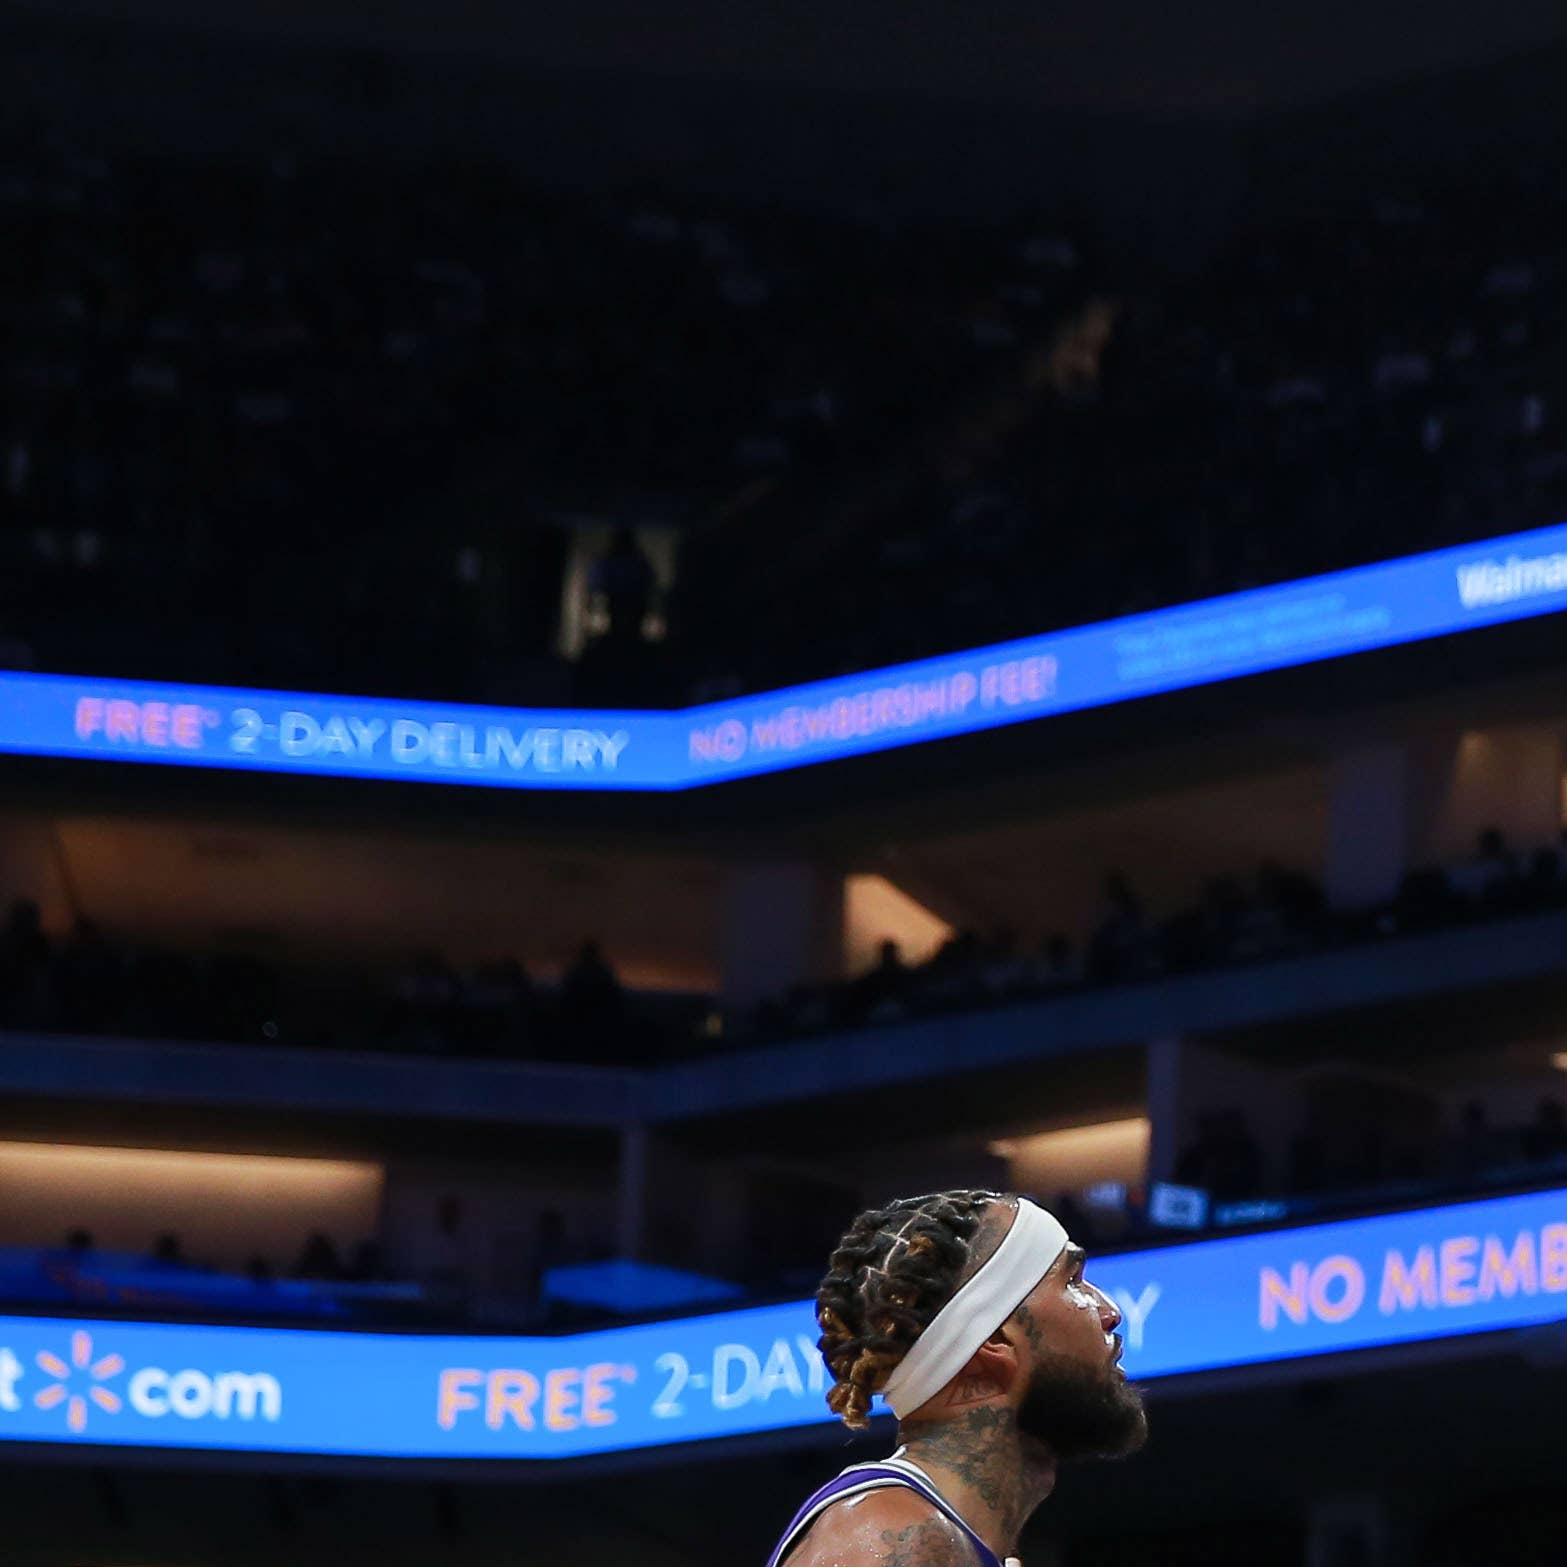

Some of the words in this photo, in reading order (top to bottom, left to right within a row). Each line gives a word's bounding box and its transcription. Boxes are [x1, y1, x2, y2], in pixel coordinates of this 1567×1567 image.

[230, 707, 386, 759] 2-DAY
[391, 717, 629, 773] DELIVERY
[1258, 1256, 1366, 1331] NO
